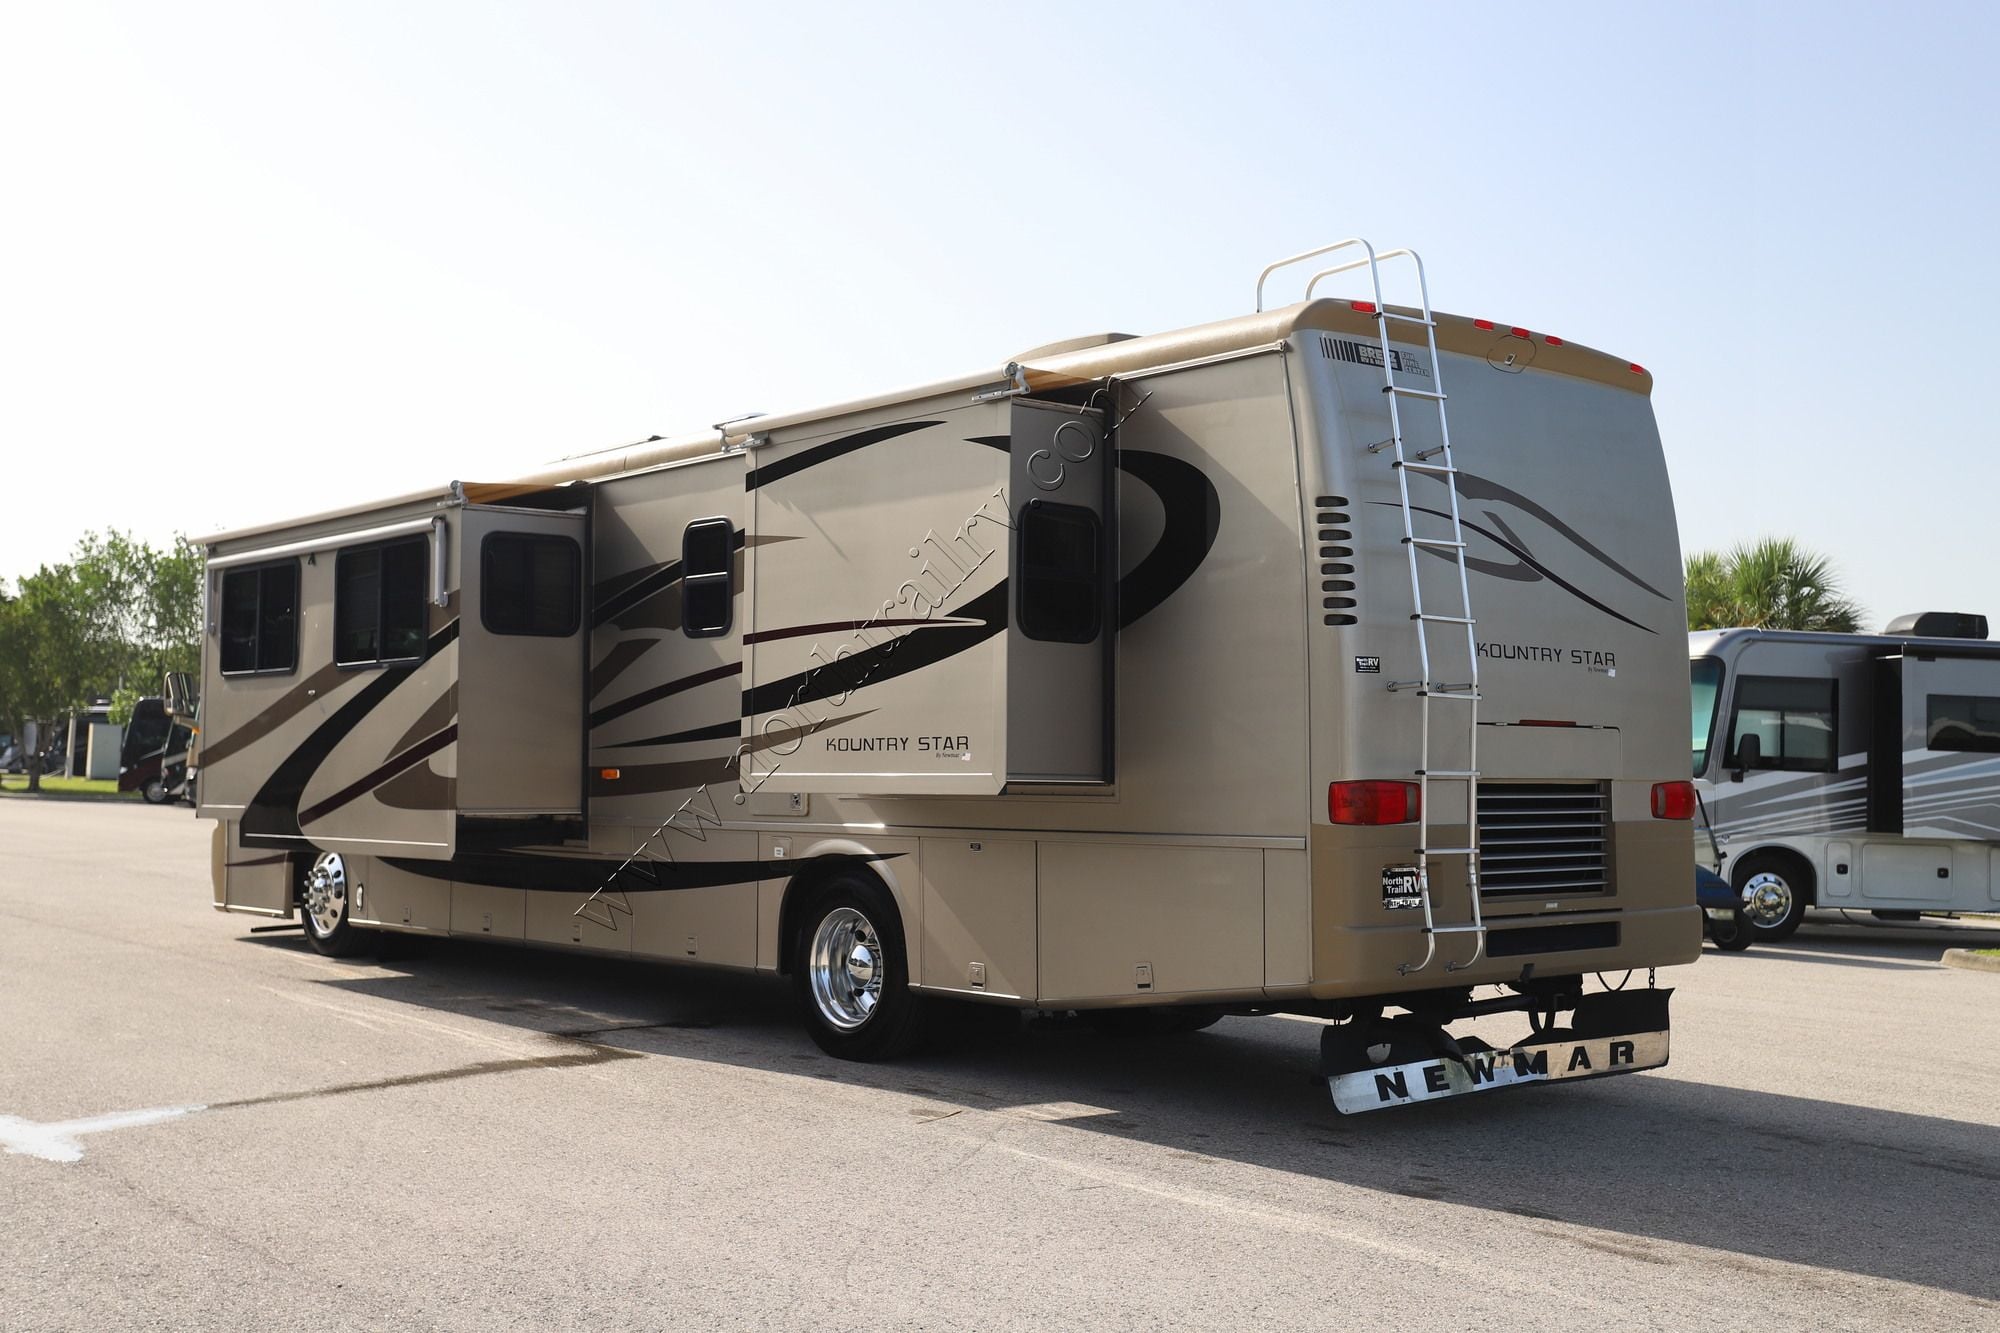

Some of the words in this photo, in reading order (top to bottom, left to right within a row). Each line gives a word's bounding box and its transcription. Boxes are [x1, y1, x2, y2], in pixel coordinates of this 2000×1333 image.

[1359, 345, 1397, 362] BREZ
[1368, 657, 1379, 666] RV
[1476, 642, 1562, 663] KOUNTRY
[1571, 649, 1616, 667] STAR
[826, 737, 909, 751] KOUNTRY
[918, 736, 969, 751] STAR
[1382, 876, 1403, 885] North
[1386, 885, 1403, 894] Trail
[1374, 1041, 1634, 1102] NEWMAR
